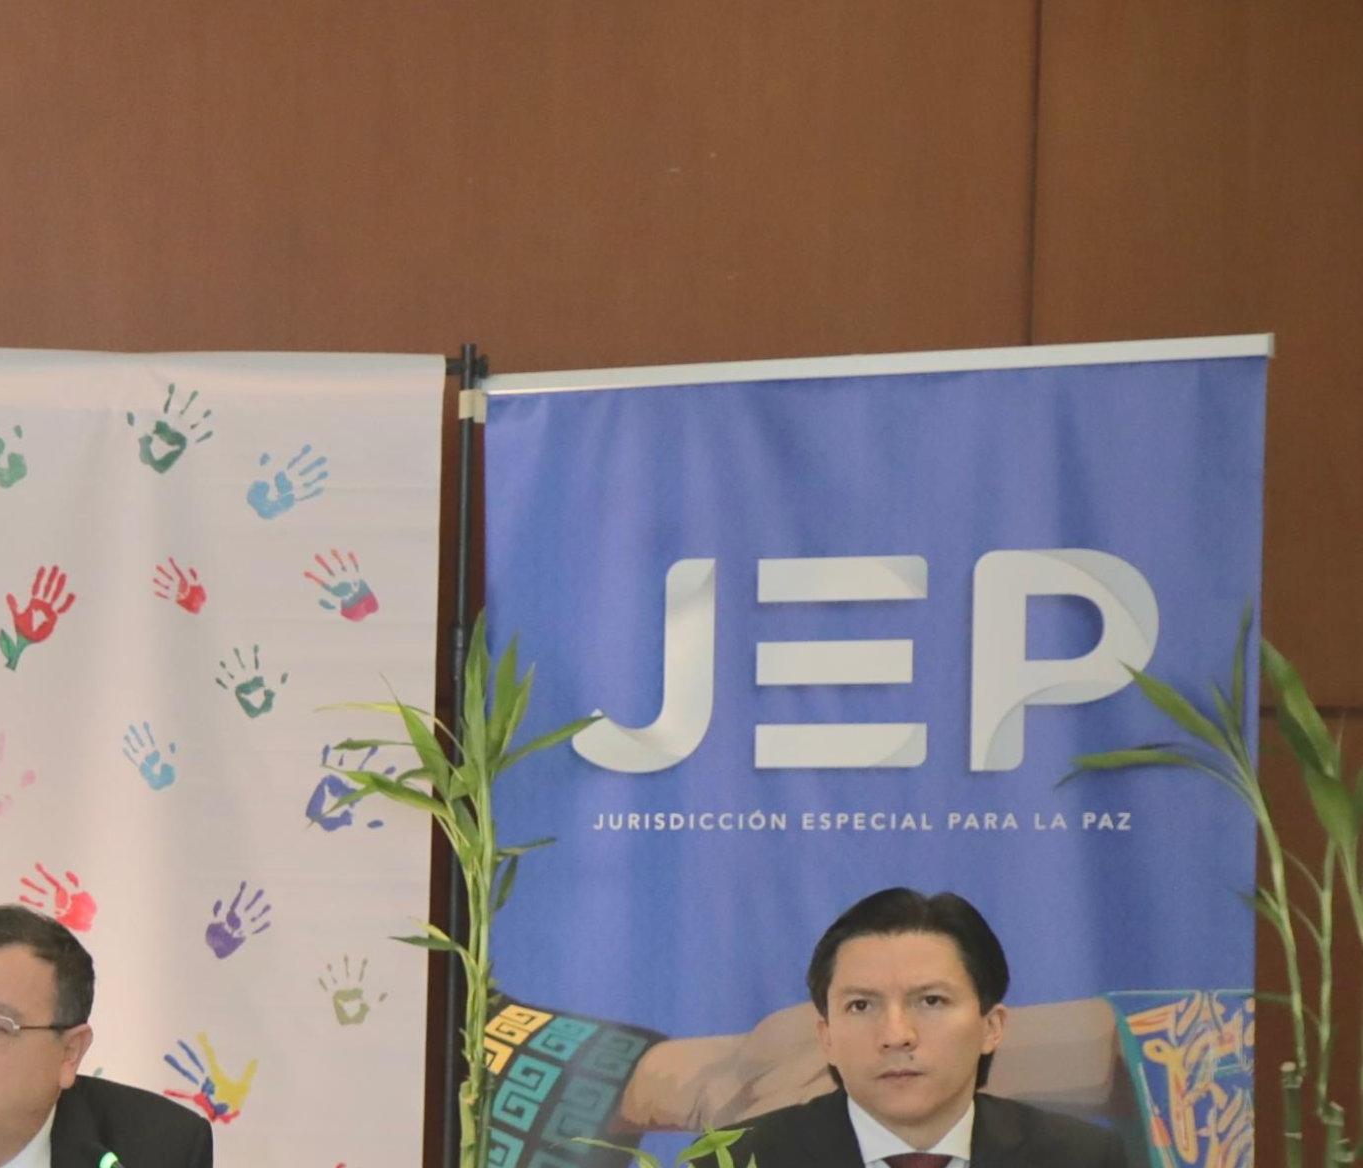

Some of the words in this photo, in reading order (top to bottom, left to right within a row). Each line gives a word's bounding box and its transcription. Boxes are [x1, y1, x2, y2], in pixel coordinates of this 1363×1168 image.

[571, 547, 1159, 772] JEP
[593, 809, 787, 831] JURISDICCIÓN
[802, 812, 933, 831] ESPECIAL
[948, 812, 1019, 831] PARA
[1035, 812, 1068, 831] LA
[1082, 812, 1133, 831] PAZ
